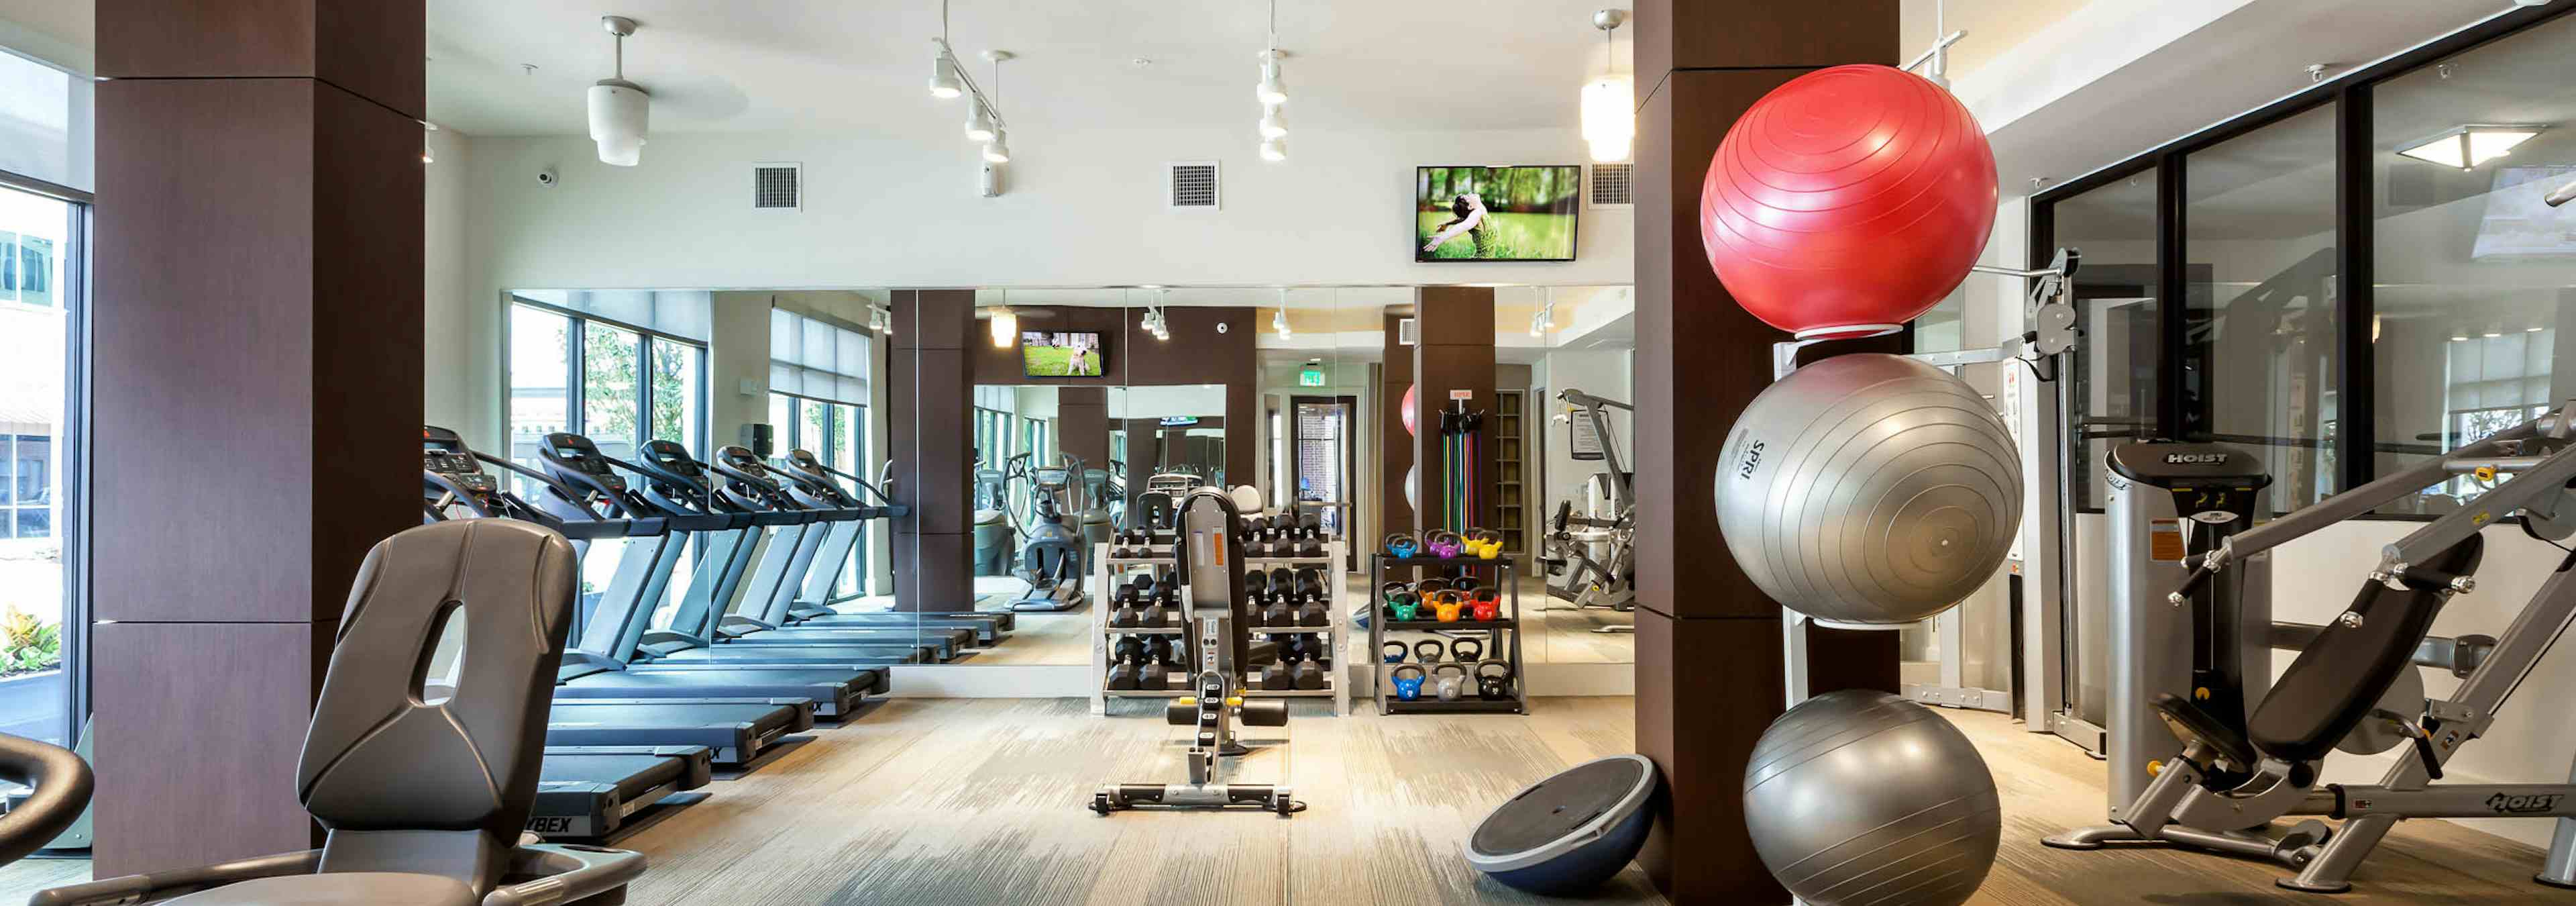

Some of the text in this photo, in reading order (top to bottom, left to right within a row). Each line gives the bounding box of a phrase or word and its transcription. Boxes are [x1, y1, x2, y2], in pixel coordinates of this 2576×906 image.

[1740, 440, 1765, 479] SPRI
[2167, 453, 2228, 464] HOIST
[2487, 793, 2563, 811] HOIST
